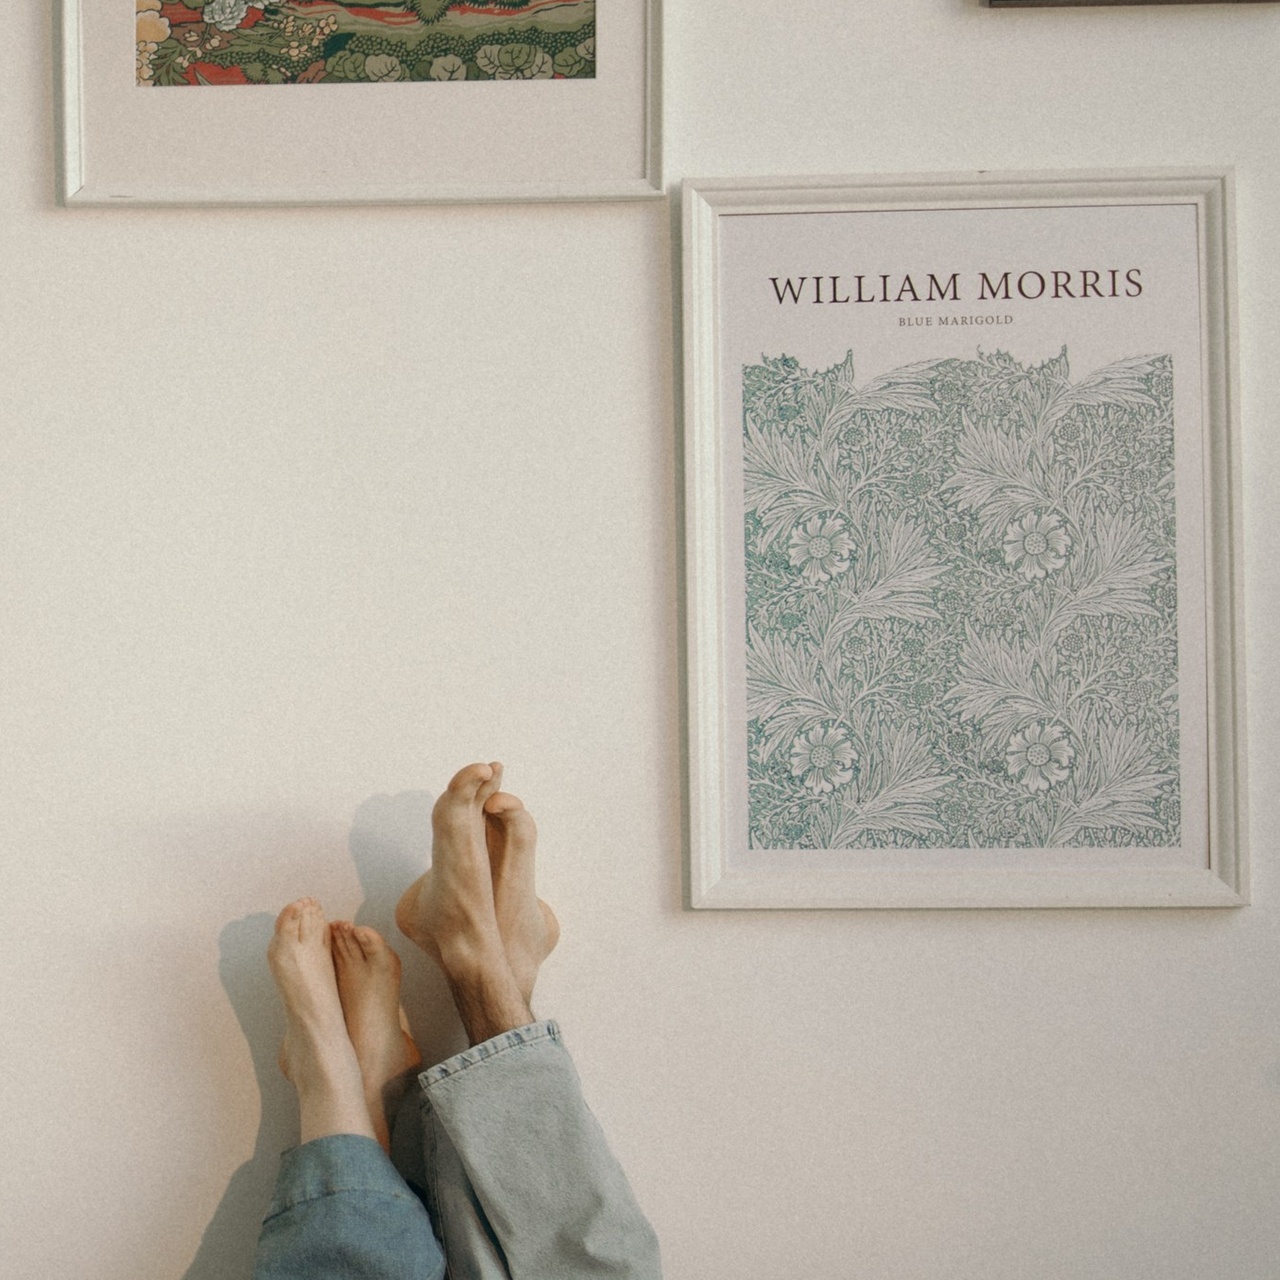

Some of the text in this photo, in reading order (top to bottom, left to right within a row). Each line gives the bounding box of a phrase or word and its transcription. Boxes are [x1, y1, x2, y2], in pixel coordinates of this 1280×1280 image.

[768, 268, 1144, 305] WILLIAM MORRIS
[898, 315, 1014, 327] BLUE MARIGOLD
